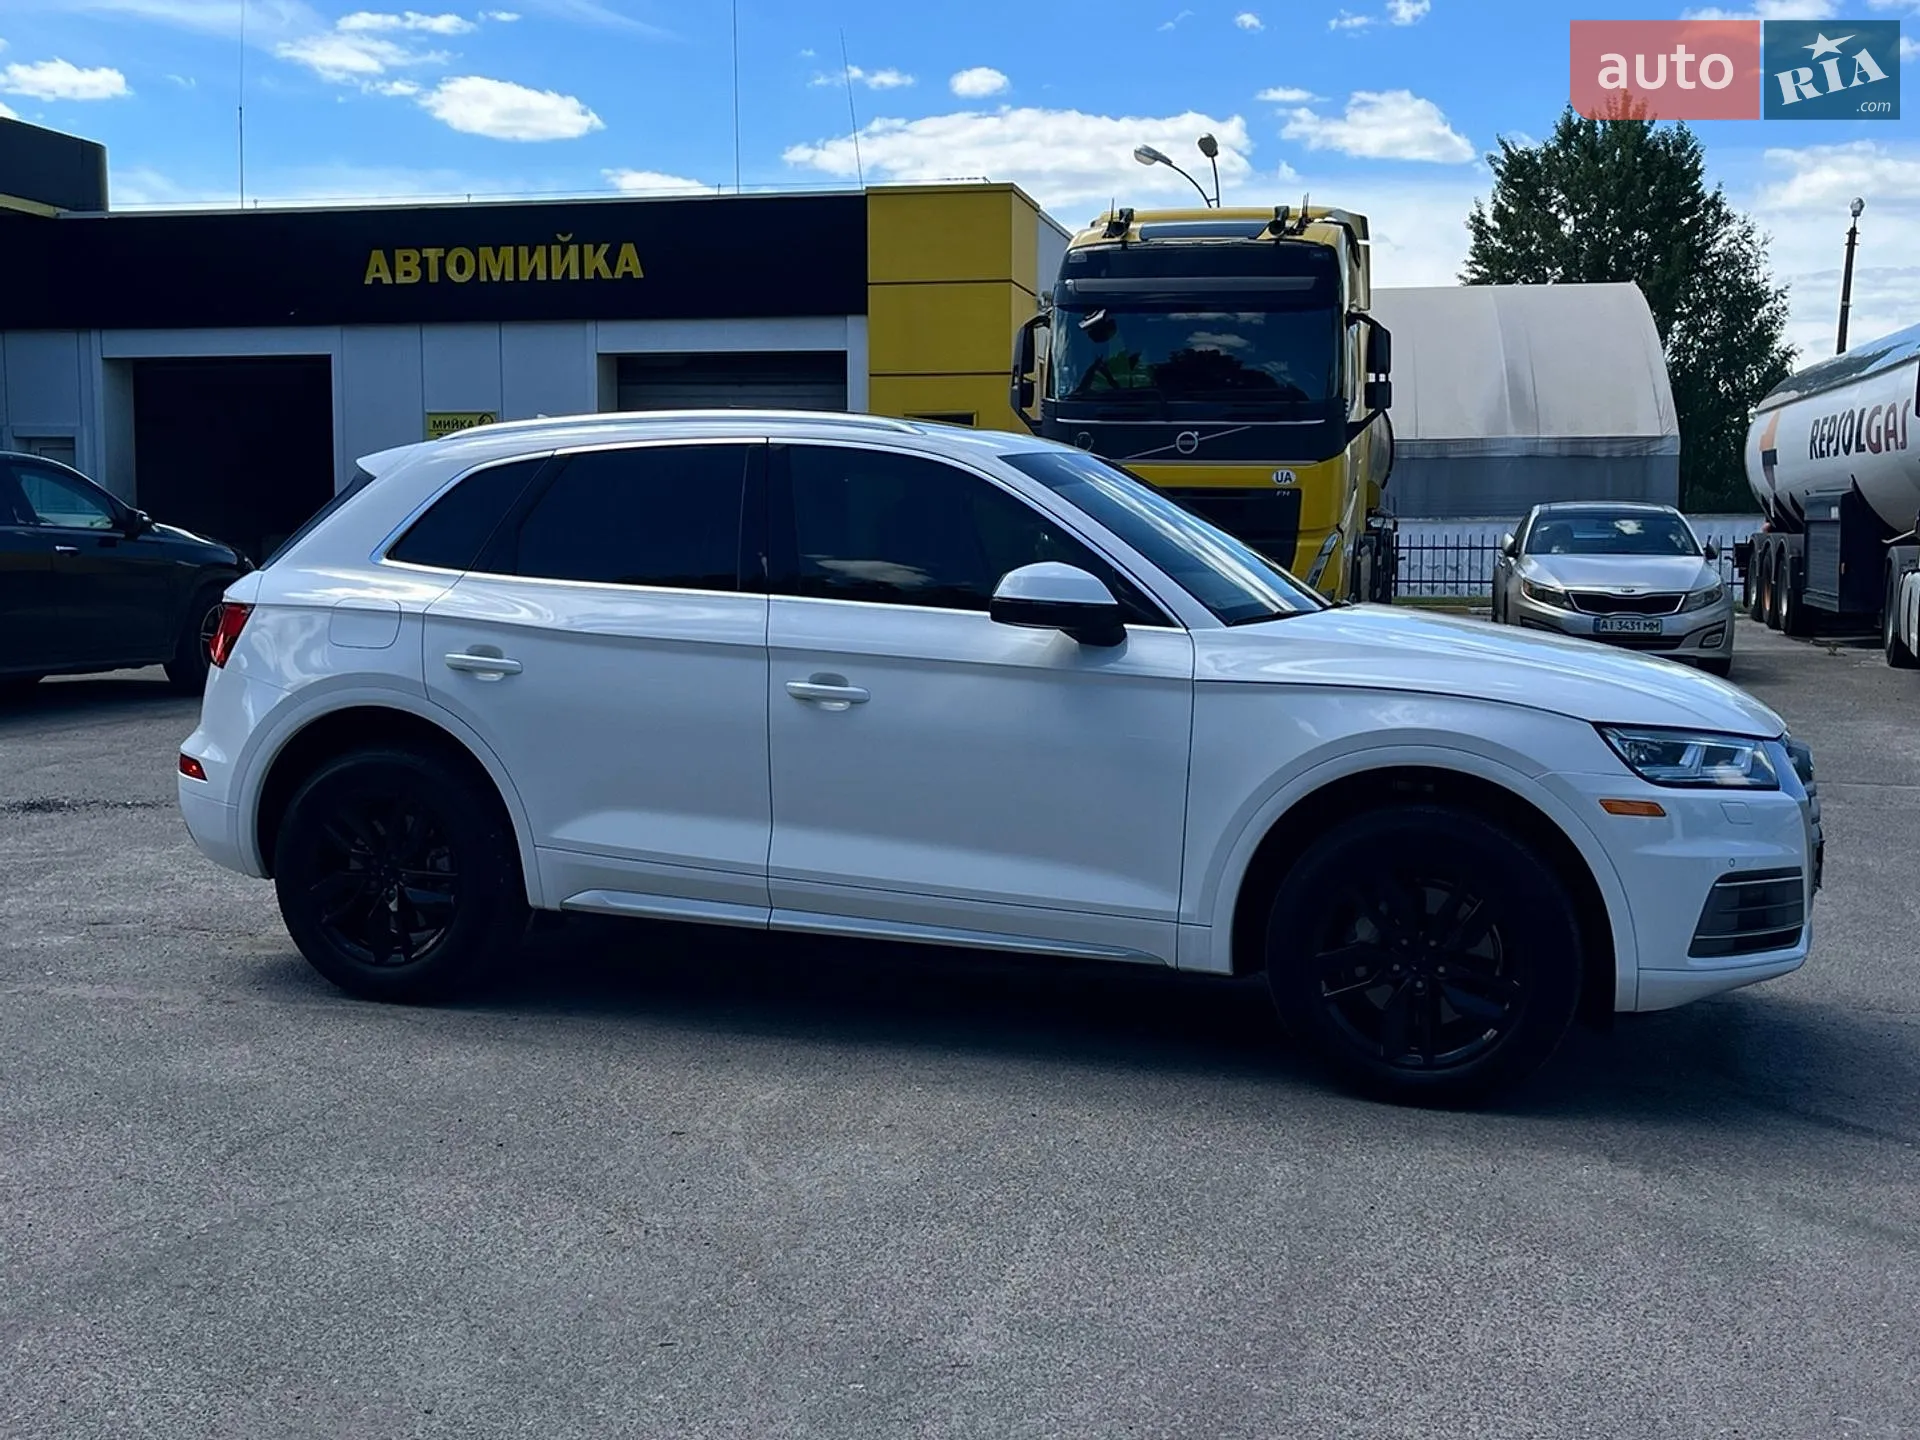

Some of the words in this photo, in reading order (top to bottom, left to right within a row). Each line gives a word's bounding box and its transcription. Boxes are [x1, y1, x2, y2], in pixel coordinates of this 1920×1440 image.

[364, 233, 644, 285] АВТОМИЙКА
[432, 418, 475, 429] МИЙКА
[1275, 471, 1293, 483] UA
[1617, 620, 1640, 631] 3431
[1643, 620, 1659, 631] MM
